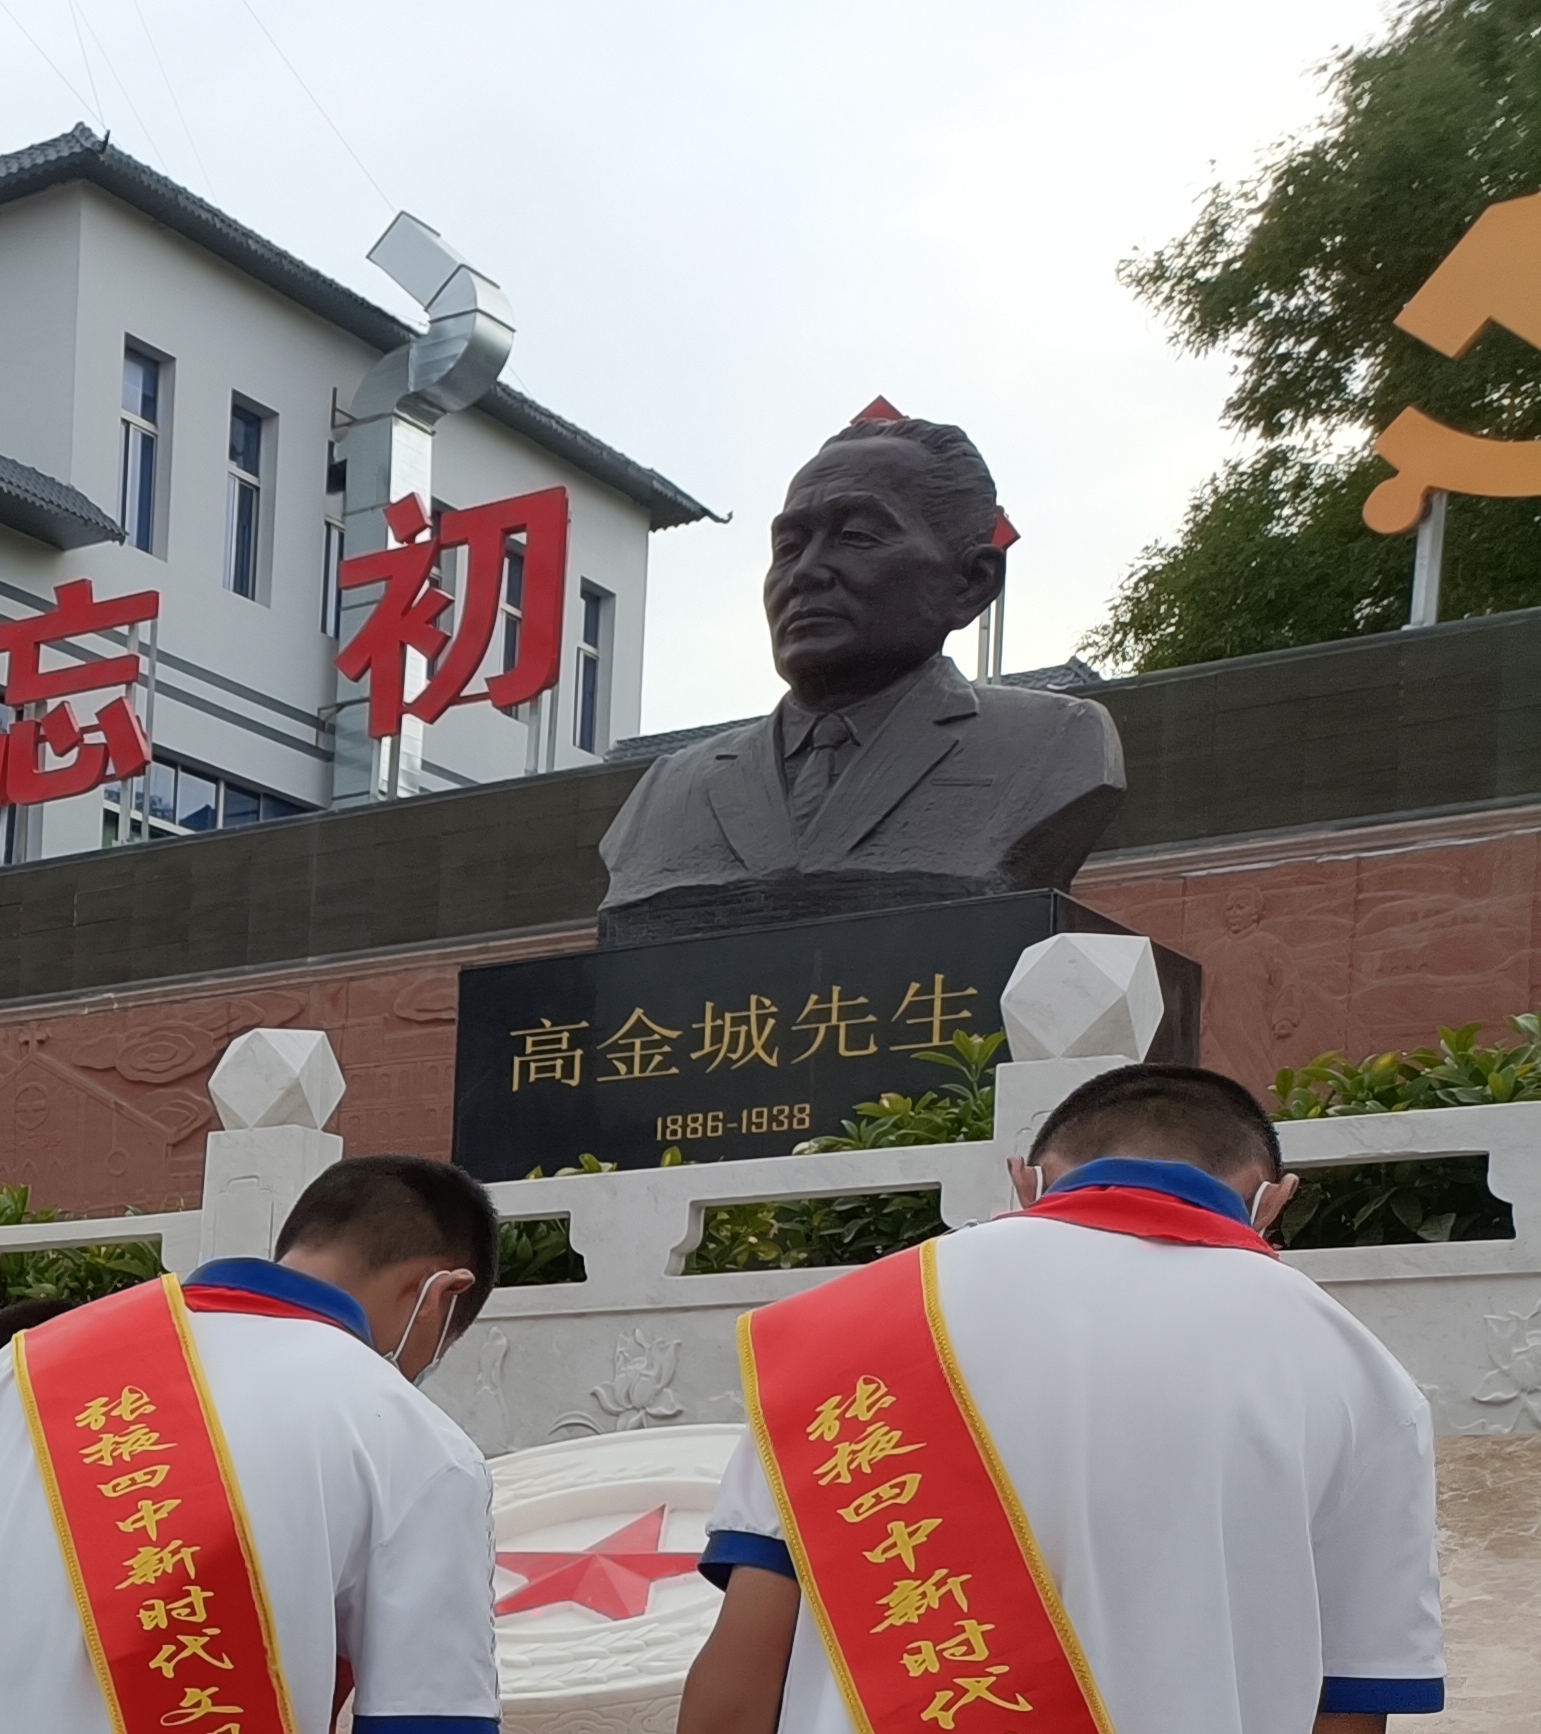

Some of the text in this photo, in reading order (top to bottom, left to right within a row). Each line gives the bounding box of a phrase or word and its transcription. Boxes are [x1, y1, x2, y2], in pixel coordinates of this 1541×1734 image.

[509, 973, 978, 1092] 高金城先生
[656, 1103, 811, 1142] 1886-1938
